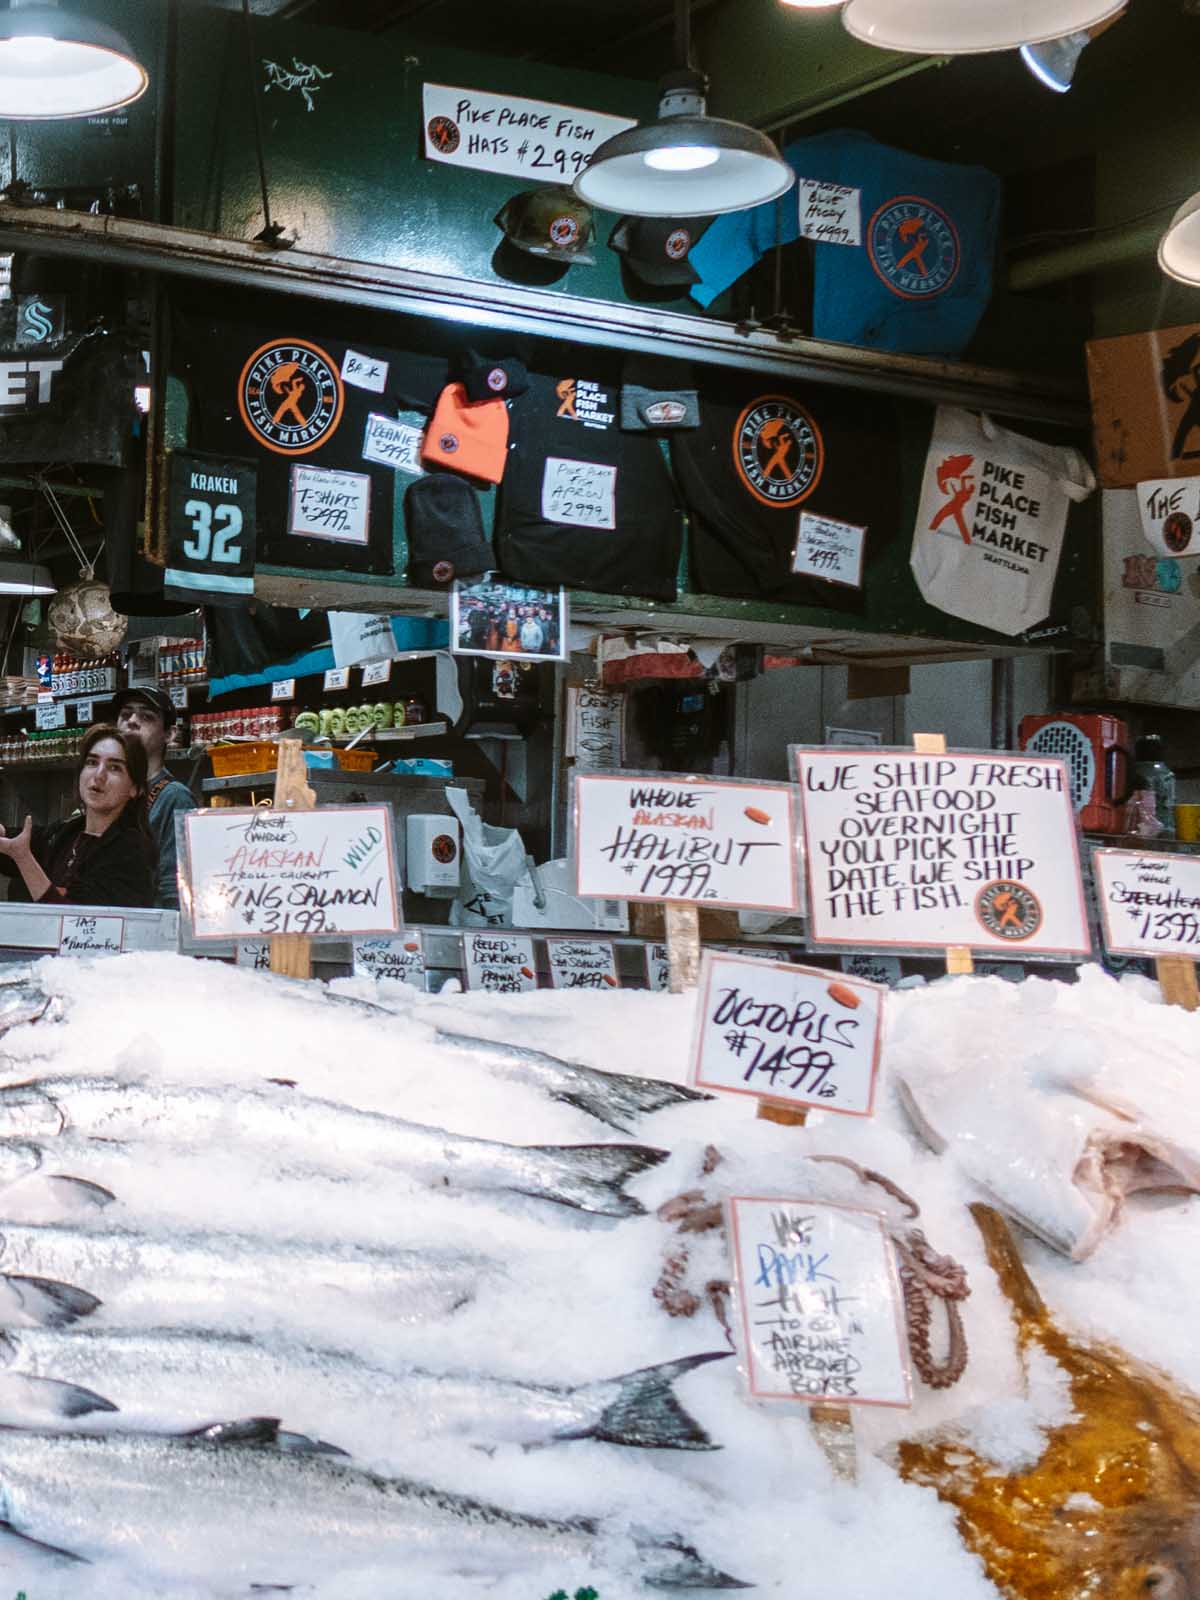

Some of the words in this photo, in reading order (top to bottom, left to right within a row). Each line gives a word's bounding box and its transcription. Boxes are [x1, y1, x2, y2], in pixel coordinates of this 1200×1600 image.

[497, 108, 551, 130] PLACE
[555, 119, 596, 141] FISH
[468, 134, 509, 156] HATS
[884, 206, 914, 230] PIKE
[919, 206, 951, 248] PLACE
[252, 351, 283, 382] PIKE
[292, 350, 333, 389] PLACE
[576, 379, 599, 392] PIKE
[576, 389, 609, 404] PLACE
[250, 401, 275, 434] FISH
[279, 409, 330, 443] MARKET
[576, 401, 598, 412] FISH
[576, 410, 616, 424] MARKET
[745, 409, 773, 437] PIKE
[777, 406, 816, 444] PLACE
[191, 472, 238, 495] KRAKEN
[744, 456, 764, 488] FISH
[768, 465, 812, 496] MARKET
[982, 460, 1026, 491] PIKE
[296, 488, 360, 511] T-SHIRTS
[552, 485, 604, 500] APRON
[979, 481, 1041, 519] PLACE
[1147, 487, 1187, 520] THE
[184, 499, 243, 564] 32
[975, 502, 1018, 531] FISH
[971, 523, 1049, 563] MARKET
[807, 764, 858, 792] WE
[873, 761, 956, 786] SHIP
[969, 762, 1063, 792] FRESH
[629, 787, 710, 809] WHOLE
[855, 789, 996, 816] SEAFOOD
[632, 808, 714, 830] ALASKAN
[840, 812, 1021, 838] OVERNIGHT
[224, 836, 329, 872] ALASKAN
[343, 826, 382, 870] WILD
[600, 826, 783, 866] HALIBUT
[820, 838, 884, 867] YOU
[895, 836, 957, 861] PICK
[963, 833, 1018, 858] THE
[911, 860, 954, 885] WE
[963, 859, 1035, 881] SHIP
[287, 877, 384, 909] SALMON
[825, 889, 884, 918] THE
[895, 884, 969, 911] FISH.
[473, 935, 509, 952] PEELED
[712, 987, 860, 1049] OCTOPUS
[773, 1351, 863, 1375] APPROVED
[787, 1372, 858, 1396] BOXES
